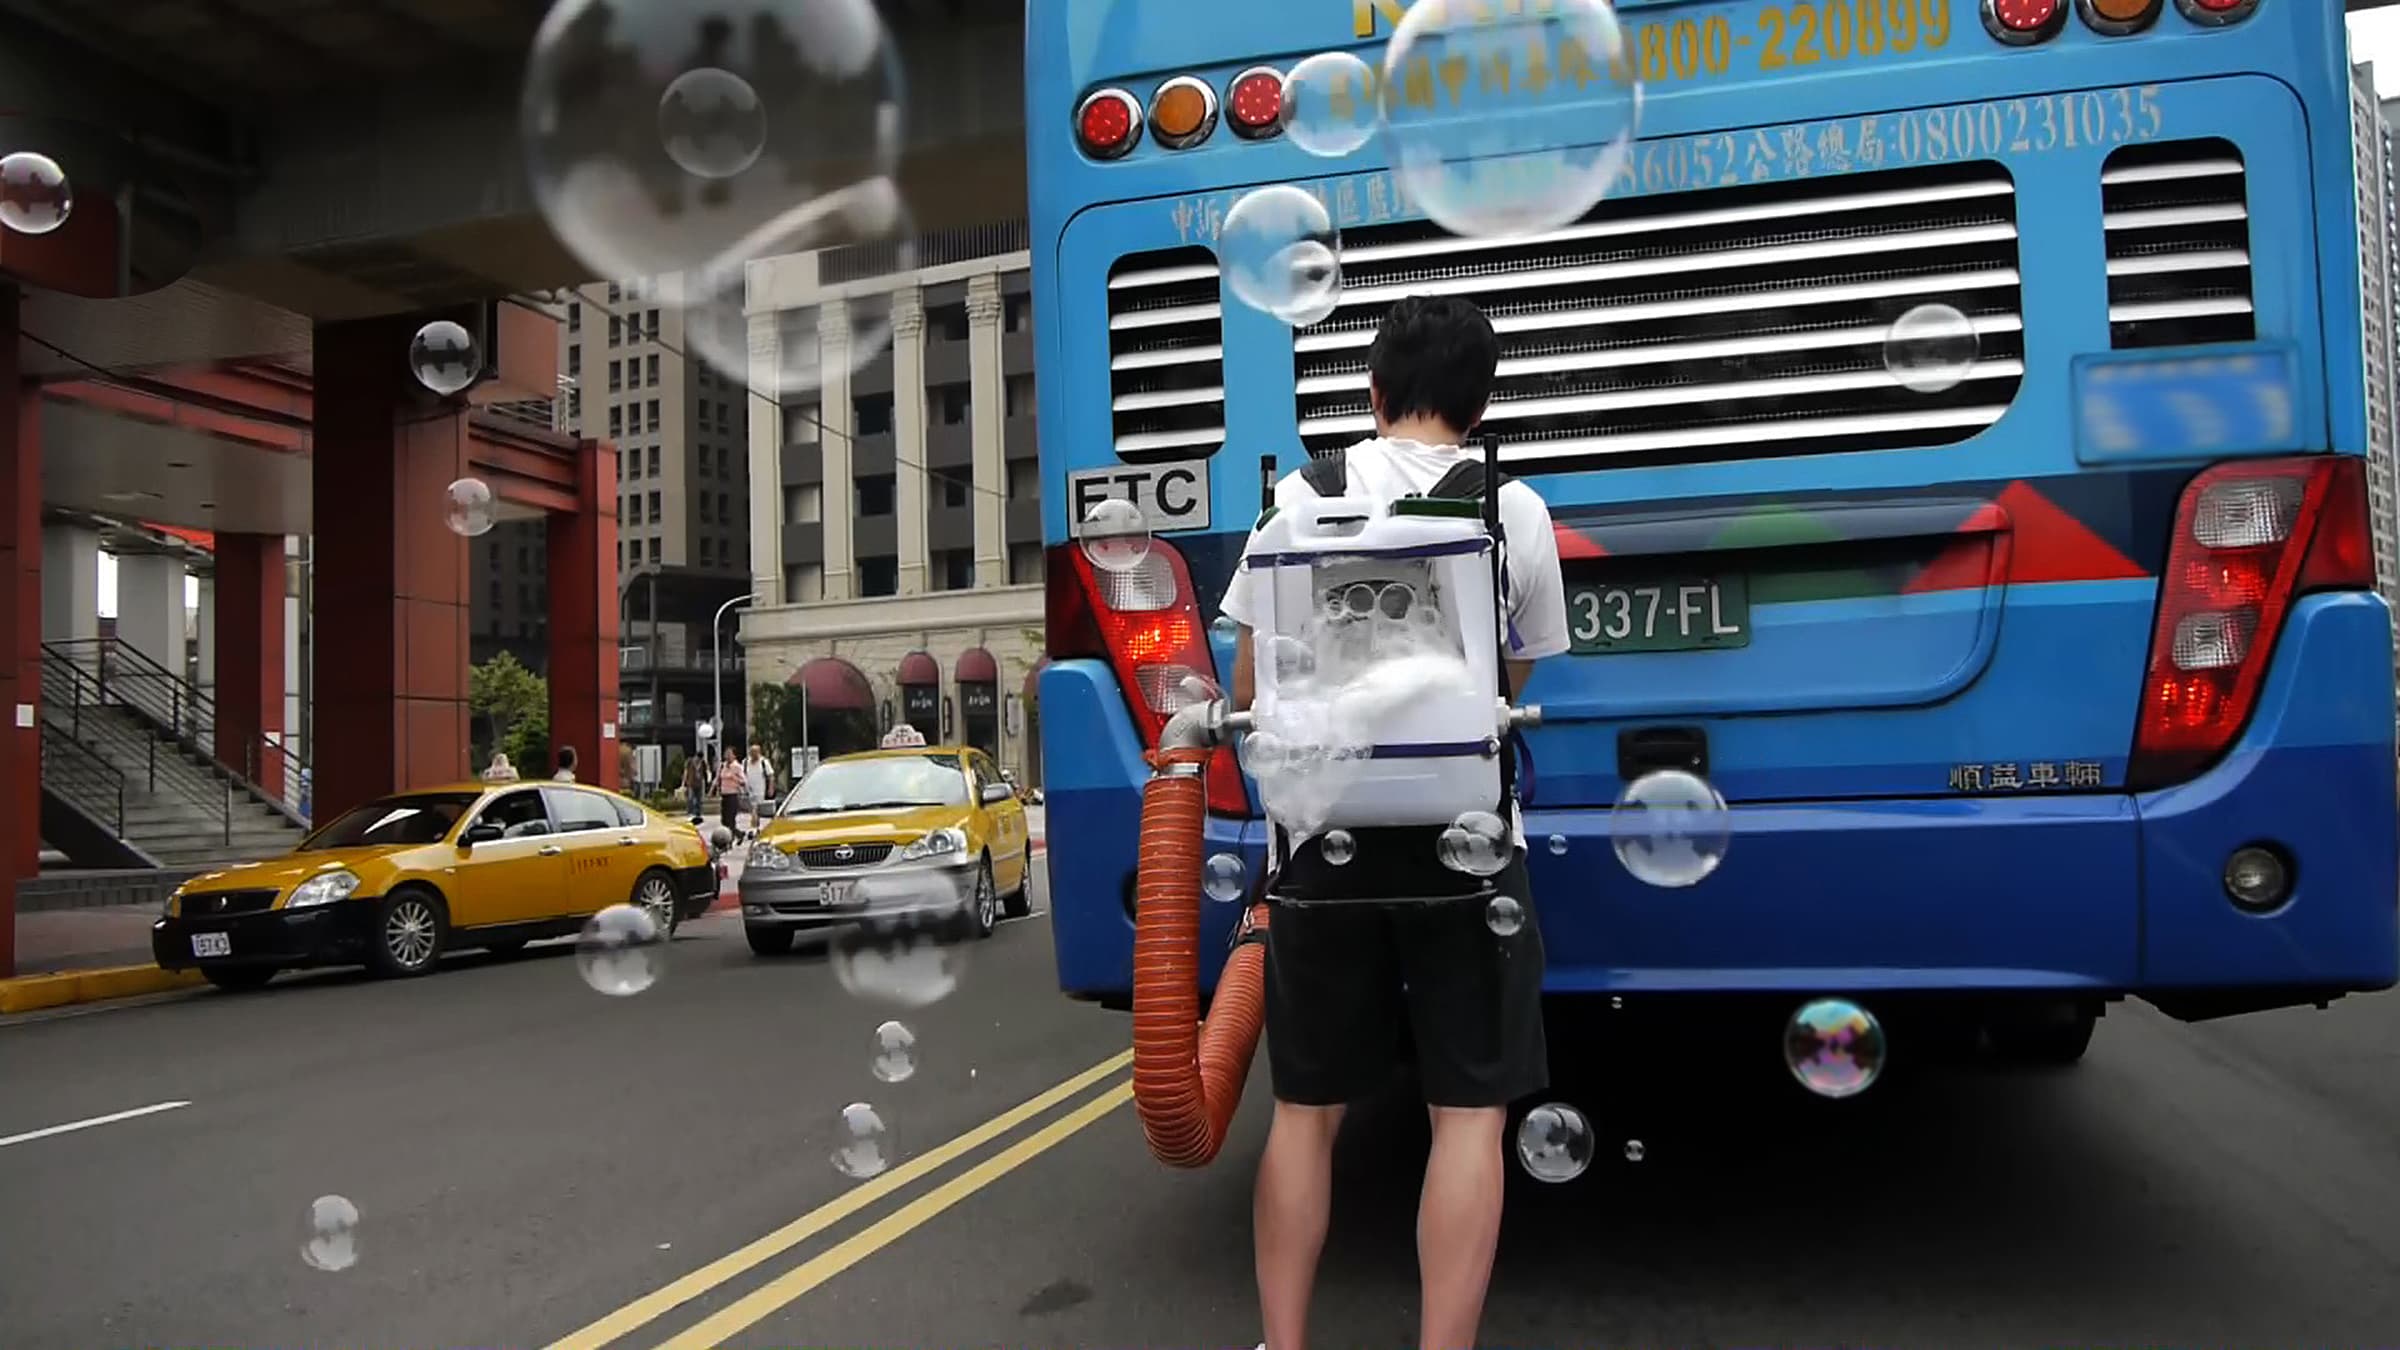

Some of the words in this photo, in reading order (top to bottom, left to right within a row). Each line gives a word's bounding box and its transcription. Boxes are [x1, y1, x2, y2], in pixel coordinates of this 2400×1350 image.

[1075, 469, 1197, 523] ETC
[1573, 585, 1740, 640] 337-FL
[1949, 760, 2102, 790] 順益車輛
